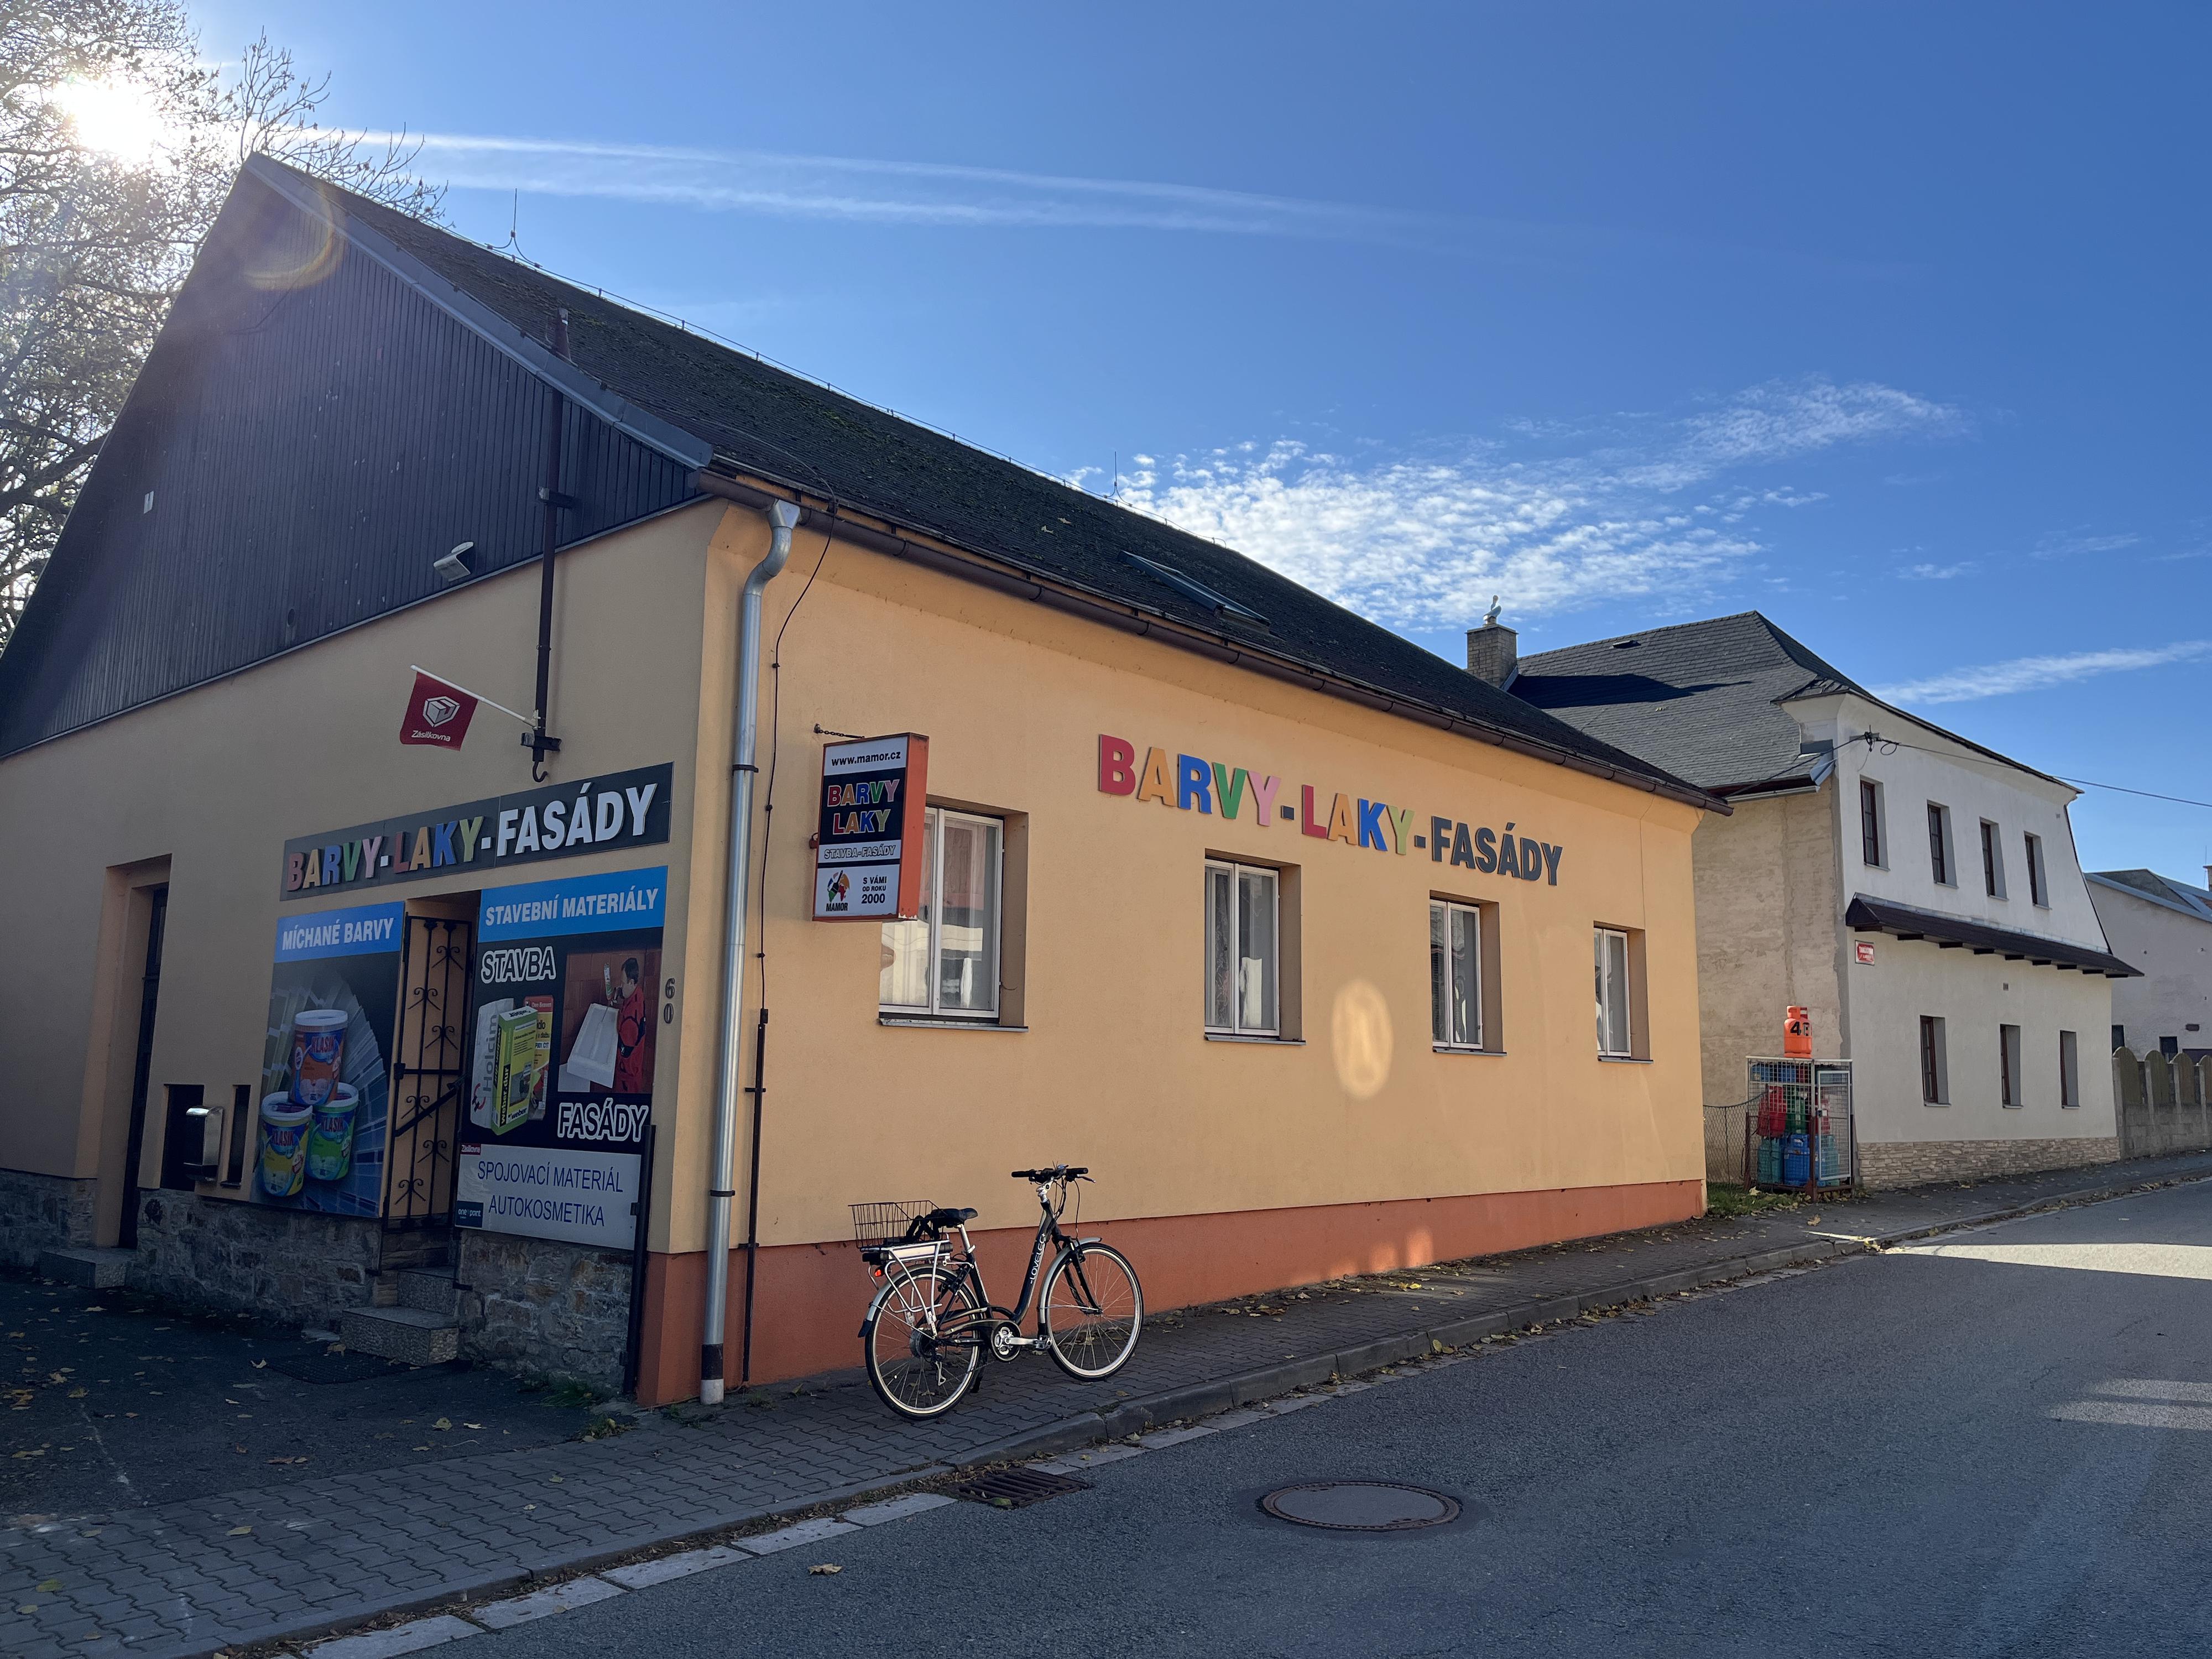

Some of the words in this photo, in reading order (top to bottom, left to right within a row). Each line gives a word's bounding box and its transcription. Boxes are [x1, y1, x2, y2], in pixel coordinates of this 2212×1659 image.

[411, 730, 451, 742] Zásilkovna
[832, 752, 901, 766] www.mamor.cz
[827, 779, 900, 807] BARVY
[833, 809, 891, 834] LAKY
[1098, 734, 1563, 885] BARVY-LAKY-FASÁDY
[287, 782, 658, 891] BARVY-LAKY-FASÁDY
[824, 844, 896, 859] STAVBA-FASÁDY
[870, 875, 886, 884] VÁMI
[486, 894, 560, 926] STAVEBNÍ
[562, 885, 659, 918] MATERIÁLY
[826, 902, 848, 911] MAMOR
[862, 894, 885, 904] 2000
[282, 919, 341, 951] MÍCHANÉ
[344, 917, 394, 943] BARVY
[481, 946, 556, 984] STAVBA
[483, 1014, 497, 1092] Holcim
[500, 1067, 510, 1124] weber.dur
[511, 1108, 528, 1120] weber
[557, 1098, 649, 1142] FASÁDY
[478, 1161, 550, 1186] SPOJOVACÍ
[553, 1167, 623, 1193] MATERIÁL
[489, 1194, 604, 1227] AUTOKOSMETIKA
